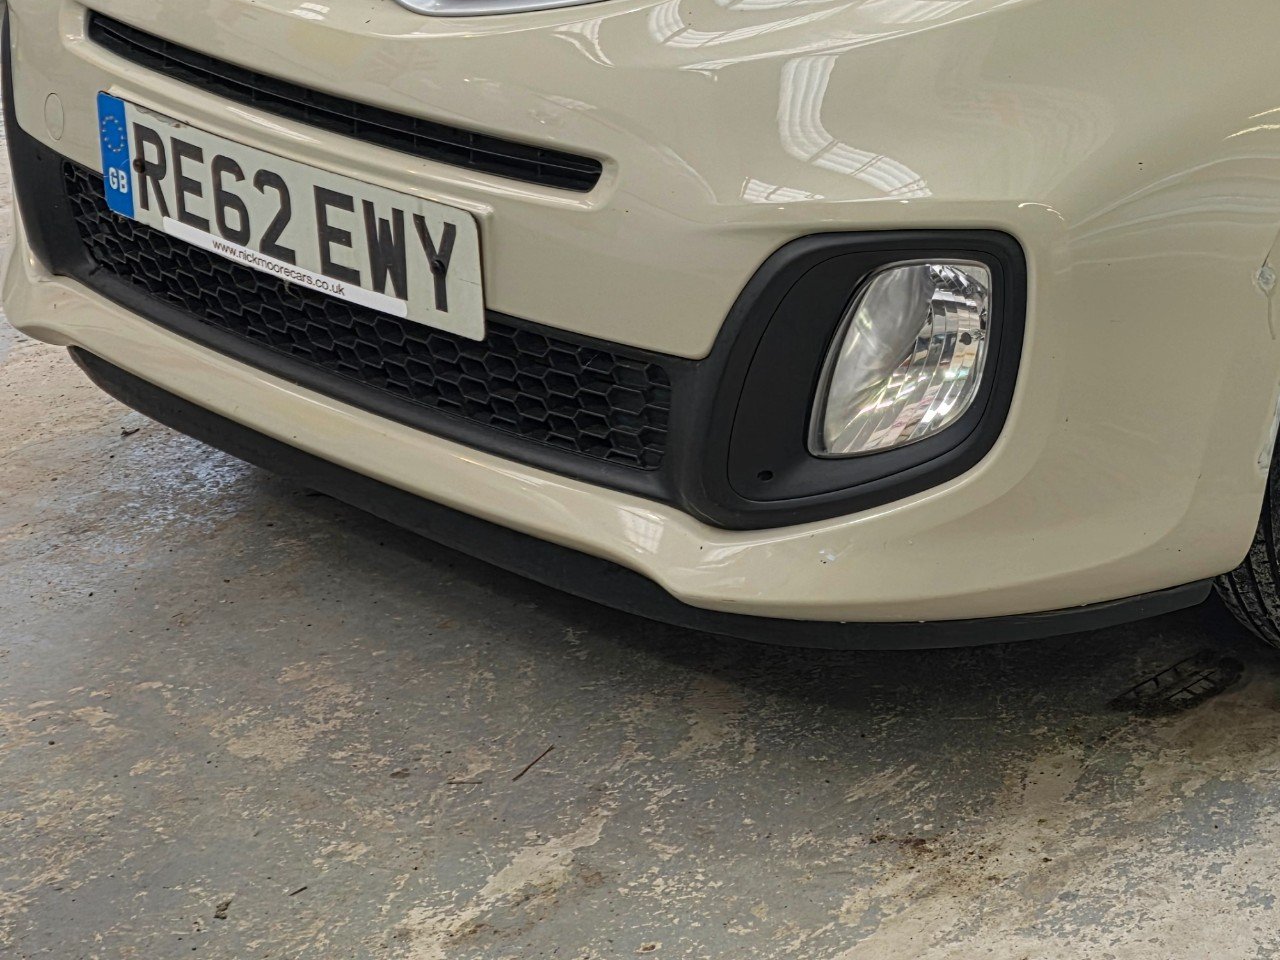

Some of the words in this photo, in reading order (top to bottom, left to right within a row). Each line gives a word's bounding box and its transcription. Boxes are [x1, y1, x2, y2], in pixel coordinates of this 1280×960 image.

[108, 166, 129, 195] GB
[132, 122, 296, 266] RE62
[313, 184, 457, 313] EWY
[212, 239, 346, 297] www.nickmoorecars.co.uk
